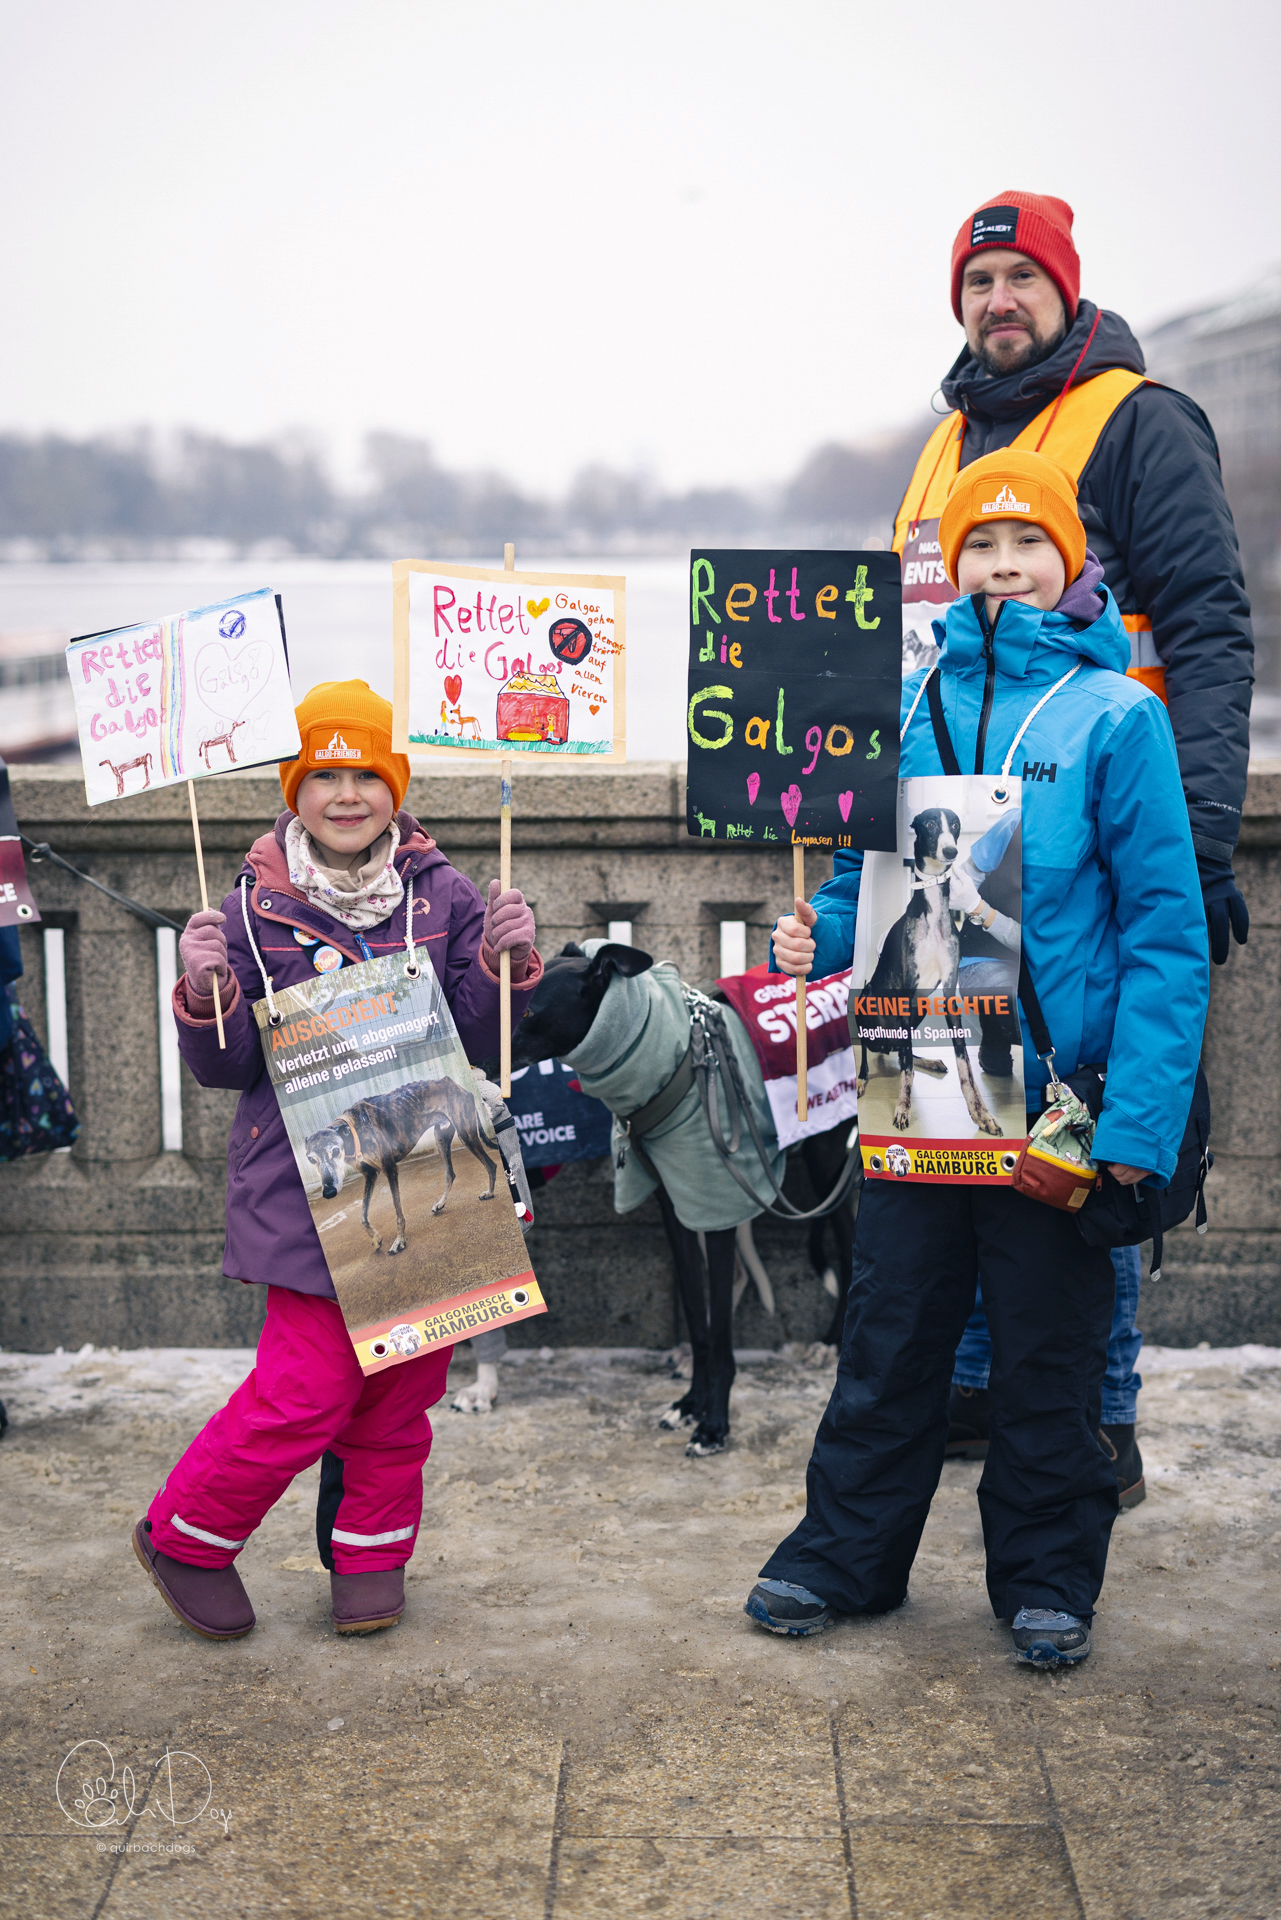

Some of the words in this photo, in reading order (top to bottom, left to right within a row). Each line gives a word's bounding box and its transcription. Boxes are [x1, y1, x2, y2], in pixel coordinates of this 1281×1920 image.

[903, 560, 950, 585] ENTS
[434, 585, 529, 637] Rettet
[555, 593, 600, 615] Galgos
[692, 558, 881, 629] Rettet
[587, 614, 614, 626] gehen
[81, 632, 163, 684] Rettet
[435, 638, 477, 670] die
[484, 641, 563, 683] Galgos
[588, 656, 606, 673] auf
[699, 630, 743, 668] die
[105, 673, 151, 708] die
[571, 683, 607, 703] Vieren
[688, 685, 881, 774] Galgos
[726, 823, 754, 839] Rettet
[763, 826, 778, 840] die
[272, 992, 396, 1052] AUSGEDIENT
[854, 996, 911, 1016] KEINE
[917, 995, 1010, 1016] RECHTE
[276, 1045, 331, 1074] Verletzt
[331, 1035, 359, 1056] und
[361, 1010, 439, 1044] abgemagert
[857, 1026, 908, 1041] Jagdhunde
[911, 1026, 921, 1039] in
[924, 1026, 972, 1041] Spanien
[284, 1071, 330, 1094] alleine
[332, 1044, 398, 1081] gelassen!
[521, 1124, 576, 1147] VOICE
[914, 1159, 998, 1175] HAMBURG
[423, 1301, 514, 1342] HAMBURG
